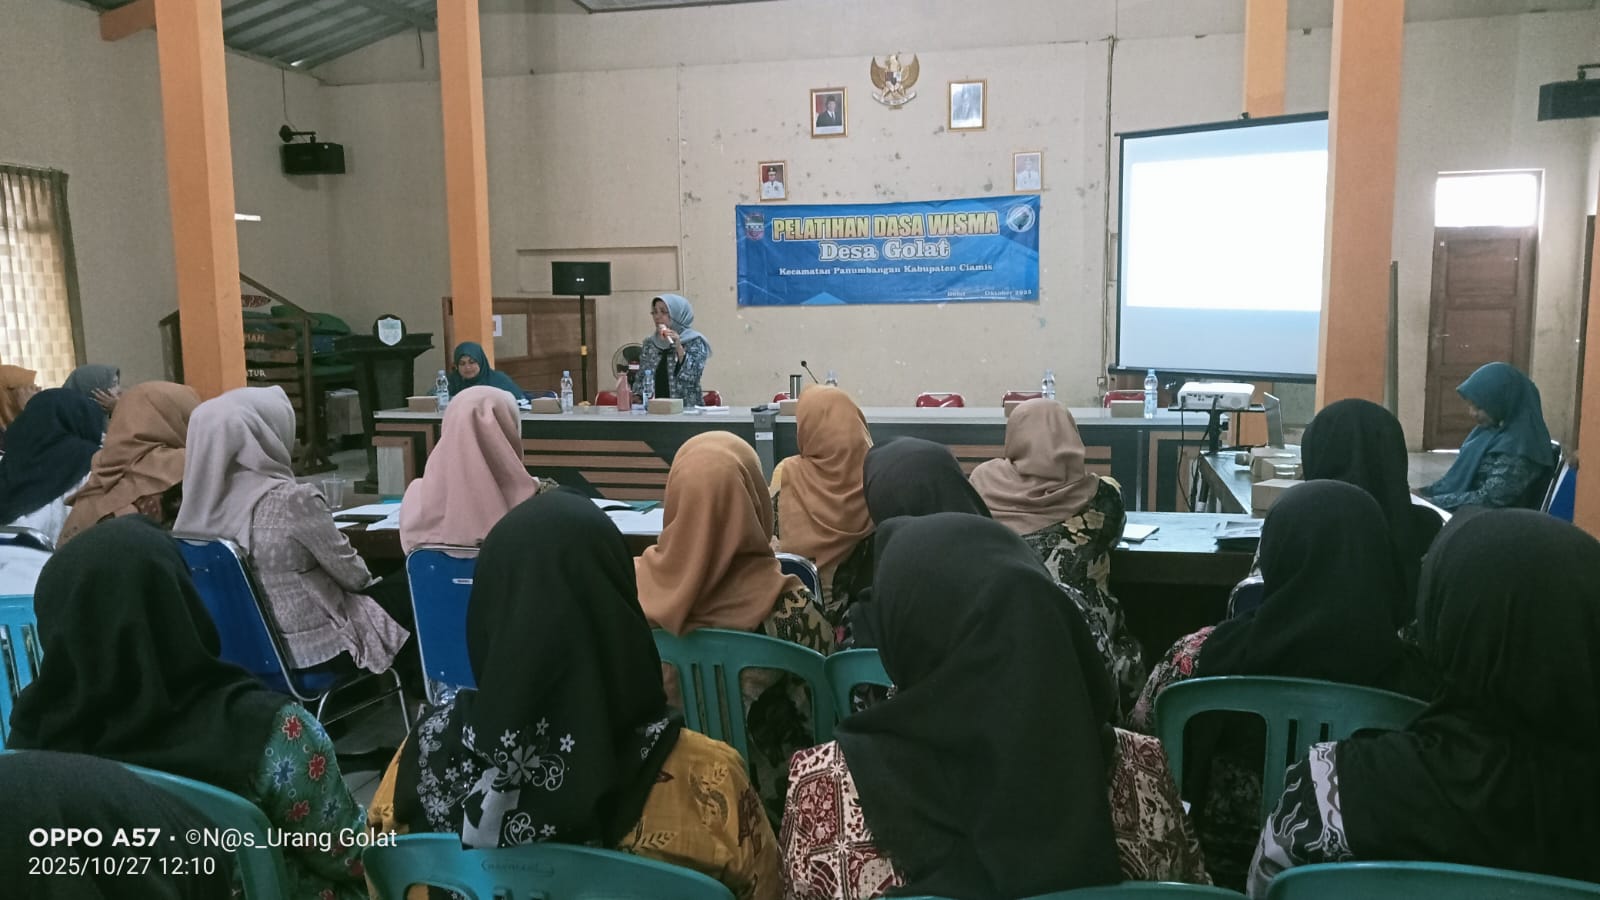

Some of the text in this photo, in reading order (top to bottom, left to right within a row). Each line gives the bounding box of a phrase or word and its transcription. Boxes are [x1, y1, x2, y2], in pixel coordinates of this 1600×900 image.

[772, 210, 999, 241] PELATIHAN DASA WISMA
[820, 239, 950, 261] Desa Golat
[779, 263, 993, 276] Kecamatan Panumbangan Kabupaten Ciamis
